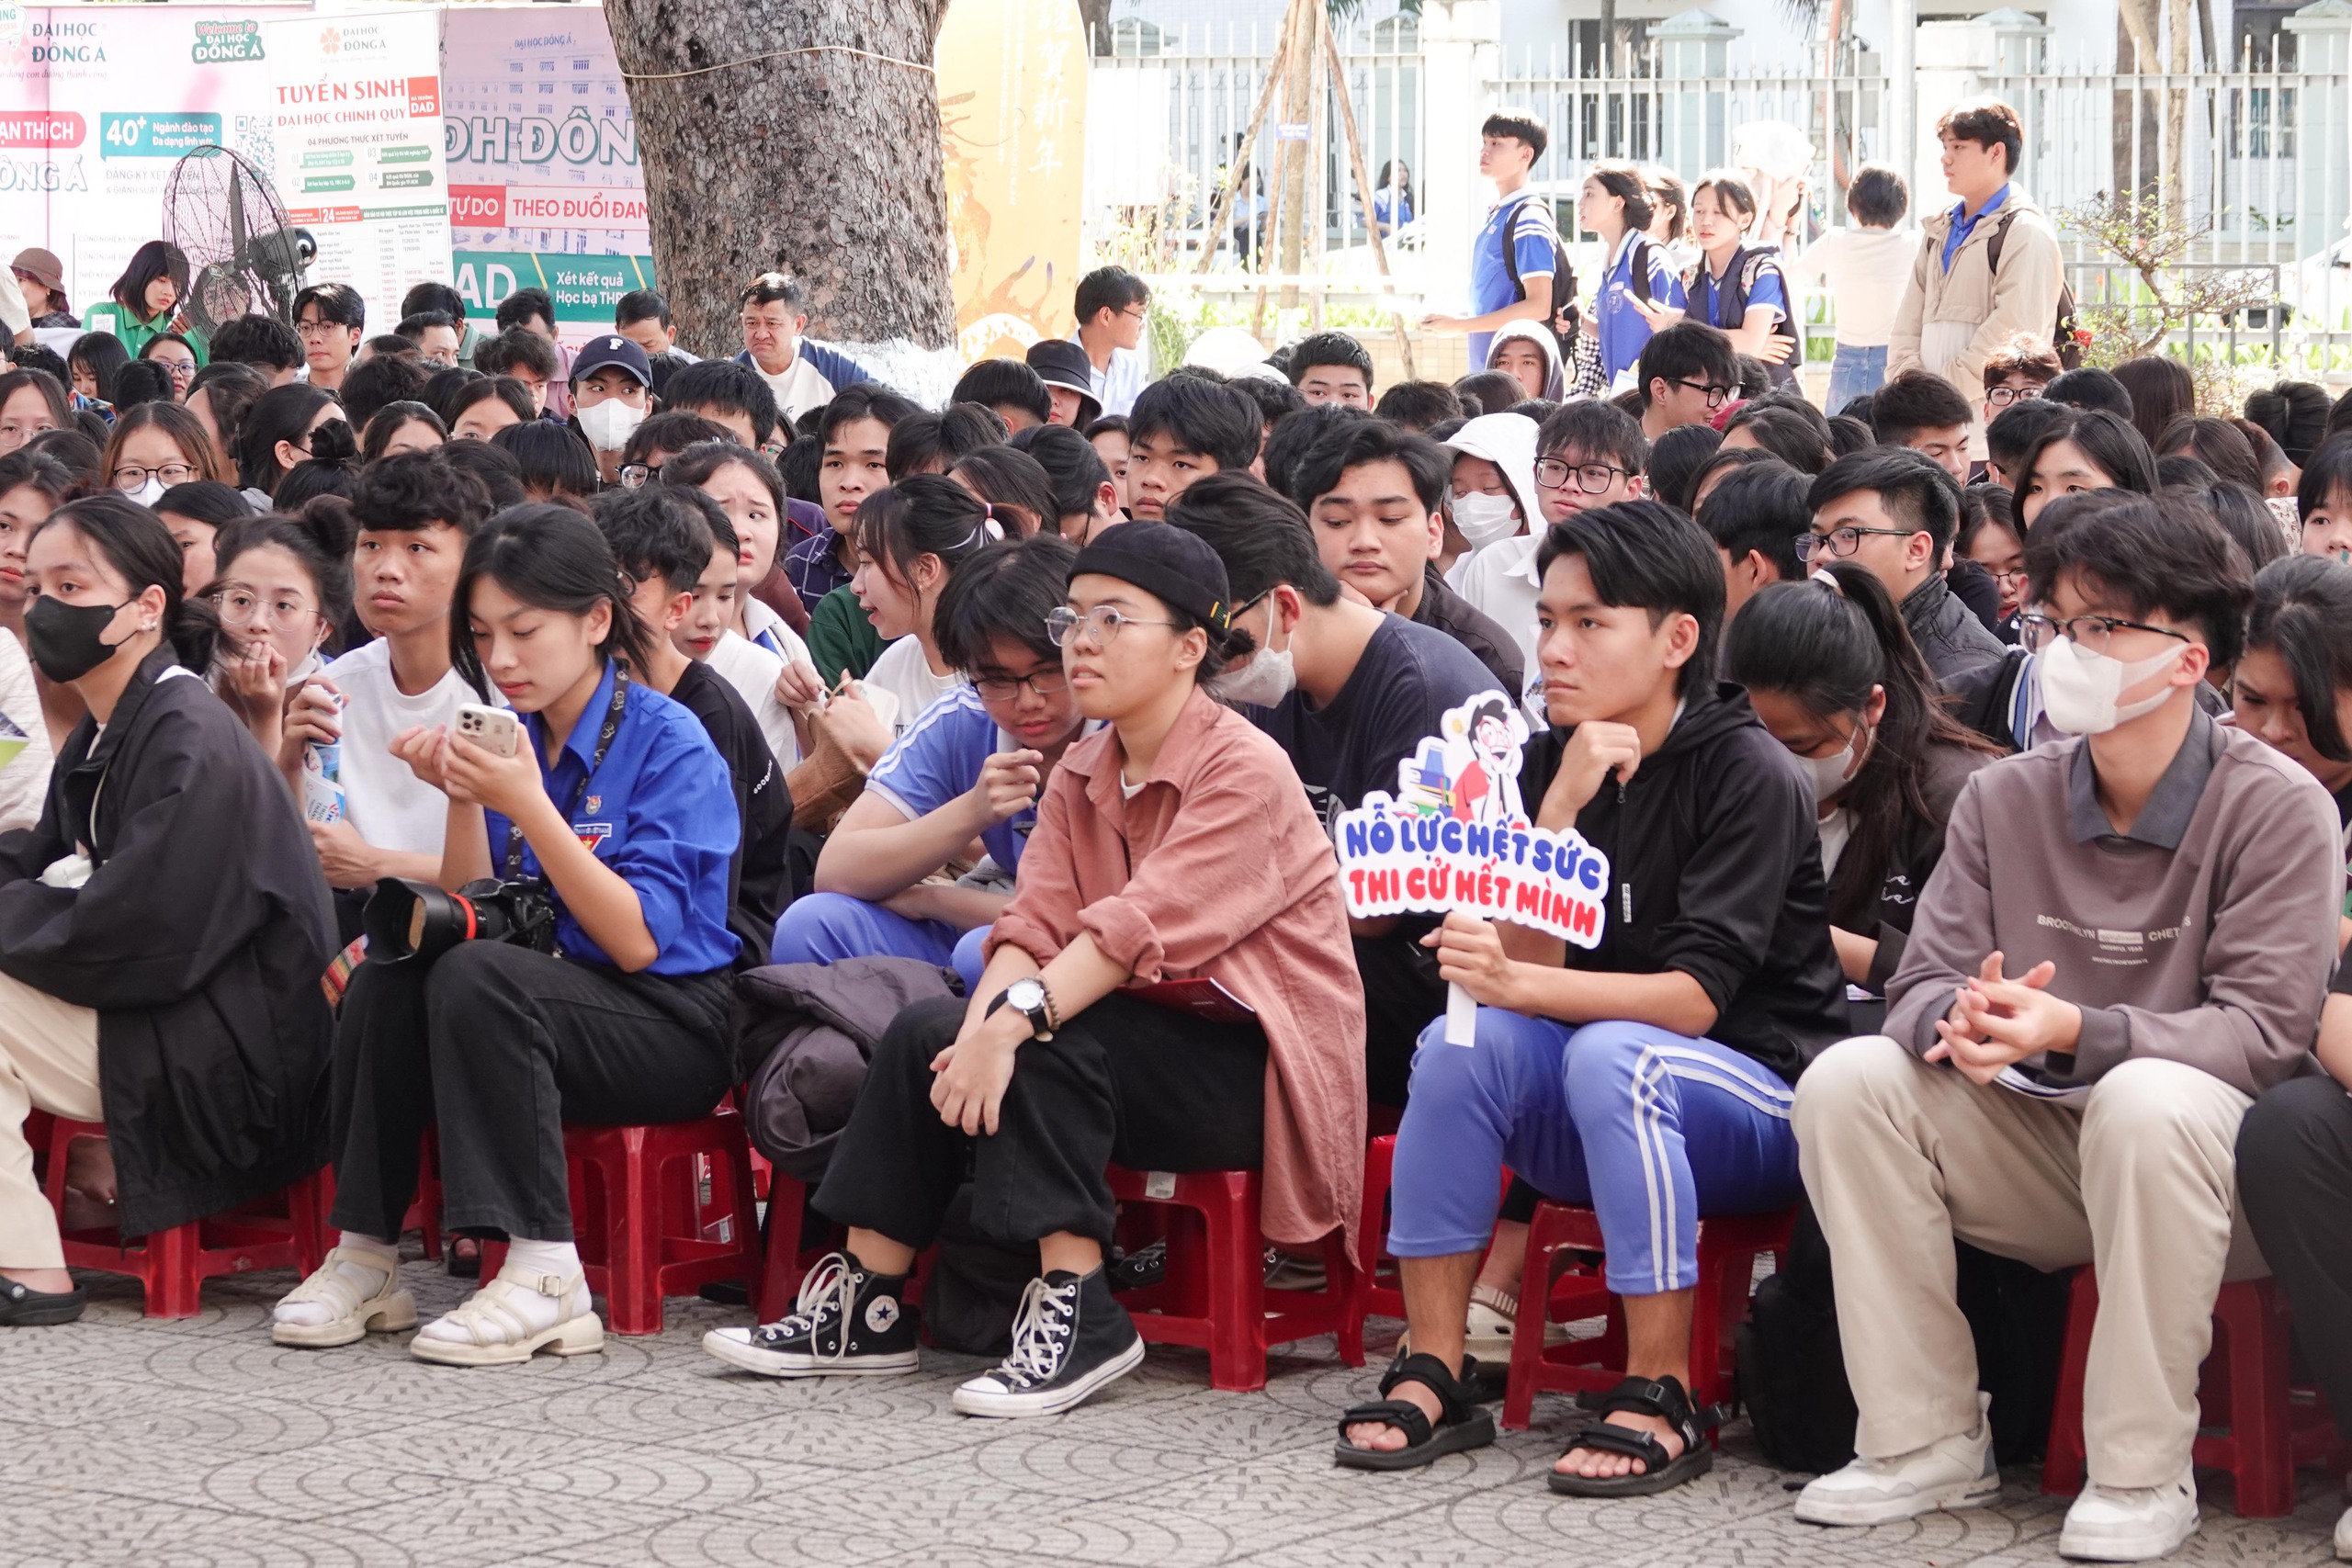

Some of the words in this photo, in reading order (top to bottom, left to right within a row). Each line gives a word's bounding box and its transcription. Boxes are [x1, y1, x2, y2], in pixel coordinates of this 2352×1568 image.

[32, 23, 60, 41] ĐẠI
[63, 23, 97, 41] HỌC
[198, 23, 242, 35] Welcome
[245, 21, 255, 33] to
[32, 41, 90, 62] ĐÔNG
[94, 40, 107, 62] Á
[196, 41, 245, 60] ĐÔNG
[249, 39, 261, 57] Á
[277, 73, 347, 105] TUYỂN
[354, 78, 406, 100] SINH
[411, 101, 435, 114] DAD
[23, 116, 74, 140] THÍCH
[153, 121, 180, 135] Ngành
[181, 120, 198, 133] đào
[199, 121, 214, 135] tạo
[277, 114, 300, 130] ĐẠI
[304, 112, 332, 128] HỌC
[379, 108, 406, 122] QUY
[153, 136, 164, 146] Đa
[164, 136, 183, 149] dạng
[308, 138, 317, 147] 04
[517, 107, 639, 166] ĐÔN
[291, 154, 300, 164] 01
[368, 148, 377, 158] 03
[65, 153, 88, 192] Á
[368, 173, 378, 182] 04
[291, 177, 300, 187] 02
[472, 198, 499, 217] DO
[513, 198, 560, 218] THEO
[563, 191, 608, 218] ĐUỔI
[322, 208, 334, 223] 24
[455, 263, 517, 309] AD
[556, 272, 577, 286] Xét
[579, 270, 599, 286] kết
[601, 271, 623, 289] quả
[556, 290, 579, 308] Học
[582, 291, 597, 308] bạ
[599, 292, 627, 305] THP
[610, 338, 623, 350] F
[1346, 803, 1395, 858] NỖ
[1401, 816, 1462, 862] LỰC
[1468, 814, 1529, 865] HẾT
[1533, 840, 1600, 890] SỨC
[1349, 868, 1399, 906] THI
[1407, 857, 1451, 900] CỬ
[1455, 858, 1511, 908] HẾT
[1516, 877, 1597, 938] MÌNH
